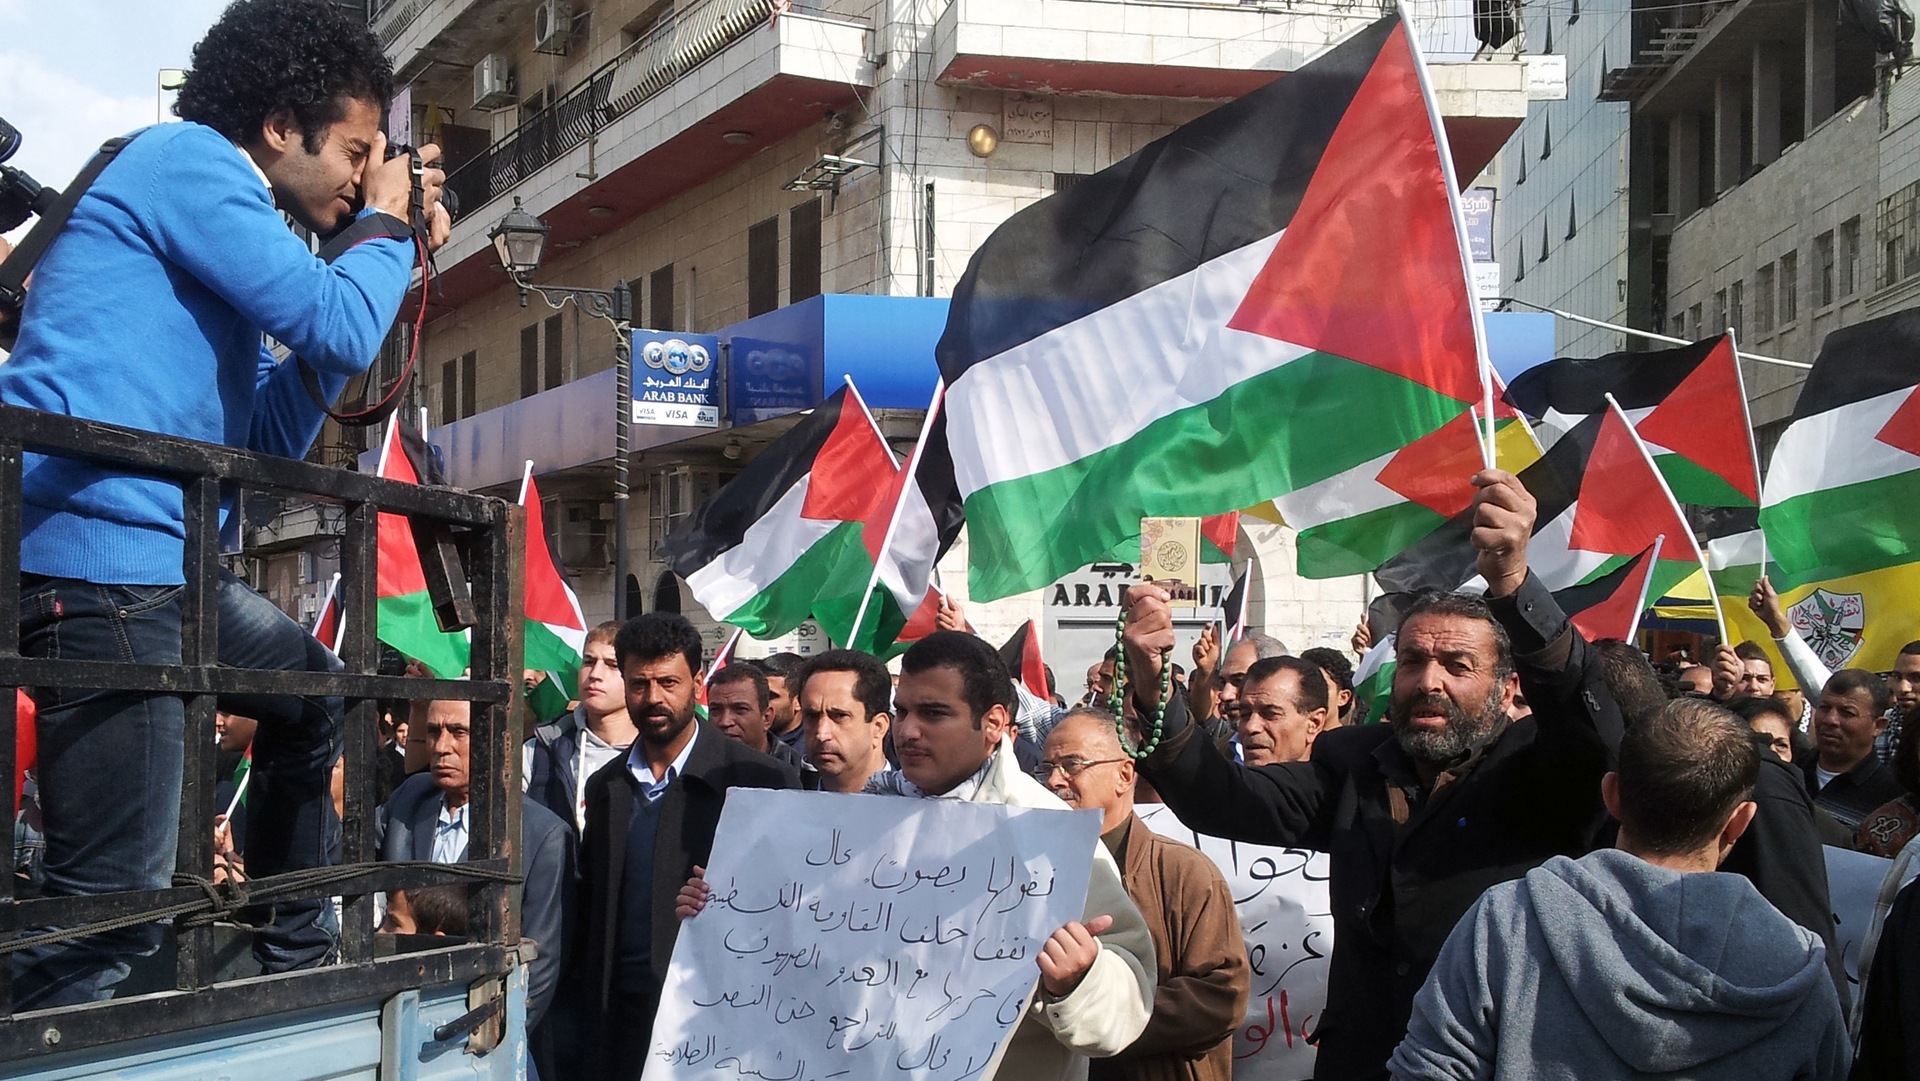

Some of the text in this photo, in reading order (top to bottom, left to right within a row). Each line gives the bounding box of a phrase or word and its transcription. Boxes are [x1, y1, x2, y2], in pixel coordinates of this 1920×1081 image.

[642, 376, 710, 391] البنك العربي
[642, 390, 710, 404] ARAB BANK
[665, 410, 689, 419] VISA
[899, 915, 969, 945] خلف
[973, 936, 1028, 961] نقف
[826, 958, 899, 987] العدو
[906, 968, 929, 999] مع
[775, 997, 816, 1024] حتى
[996, 982, 1028, 1029] في
